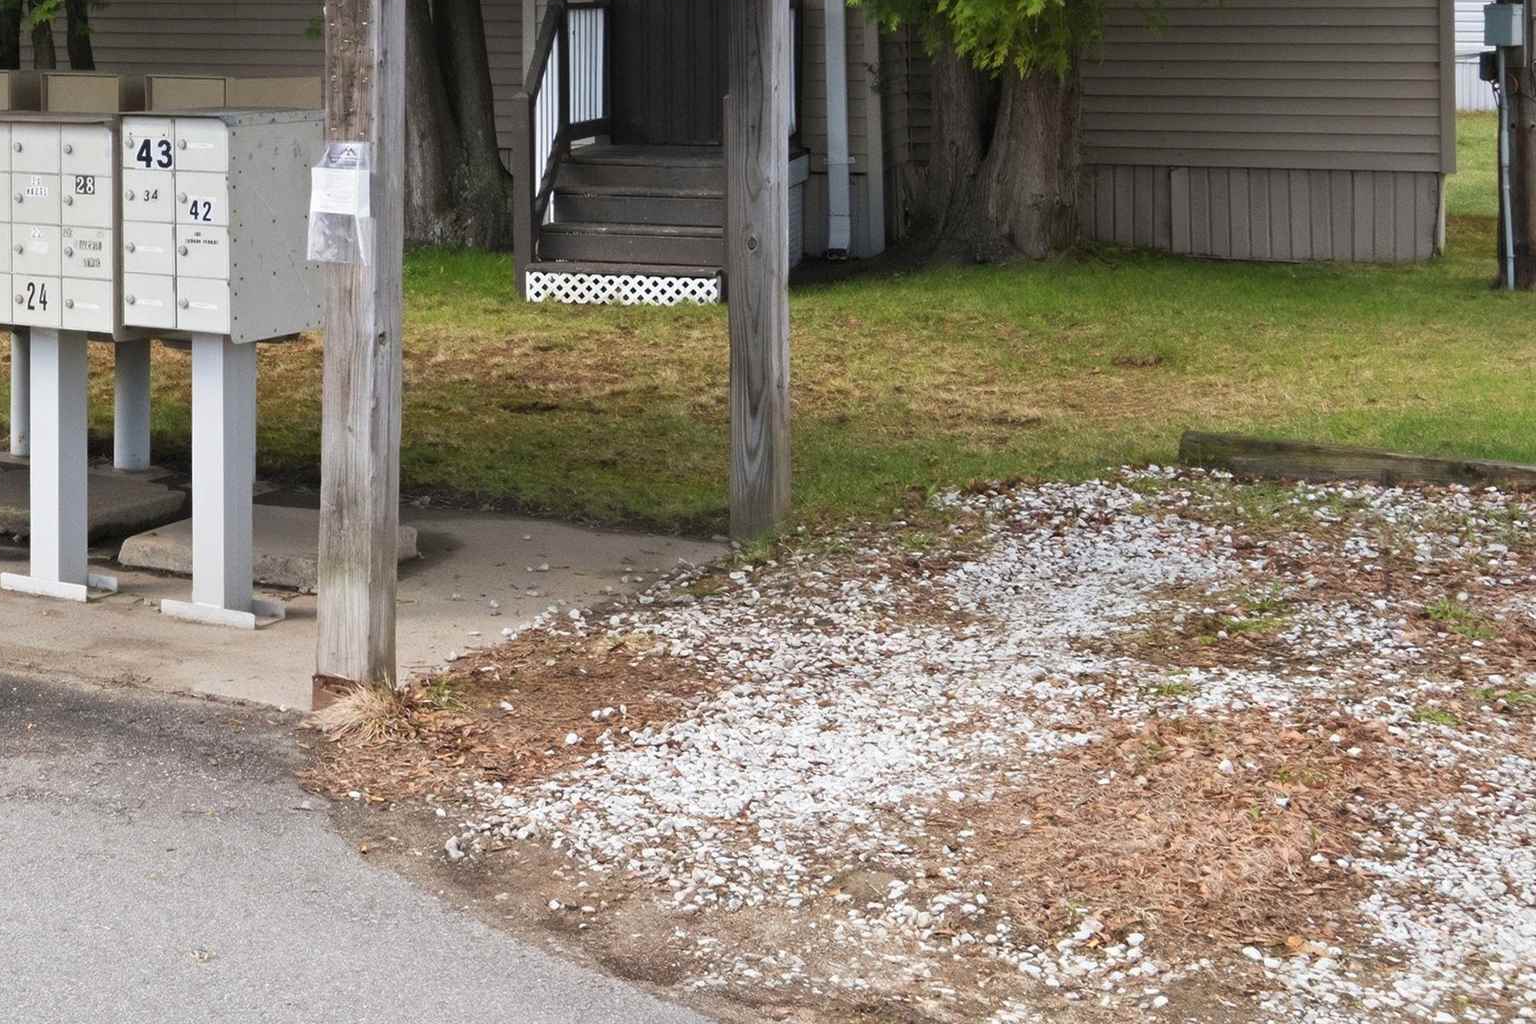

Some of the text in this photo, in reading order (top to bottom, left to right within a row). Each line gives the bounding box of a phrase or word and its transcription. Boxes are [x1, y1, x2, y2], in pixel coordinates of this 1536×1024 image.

[136, 138, 173, 169] 43
[75, 175, 96, 194] 28
[143, 189, 159, 202] 34
[189, 200, 212, 222] 42
[26, 282, 48, 311] 24
